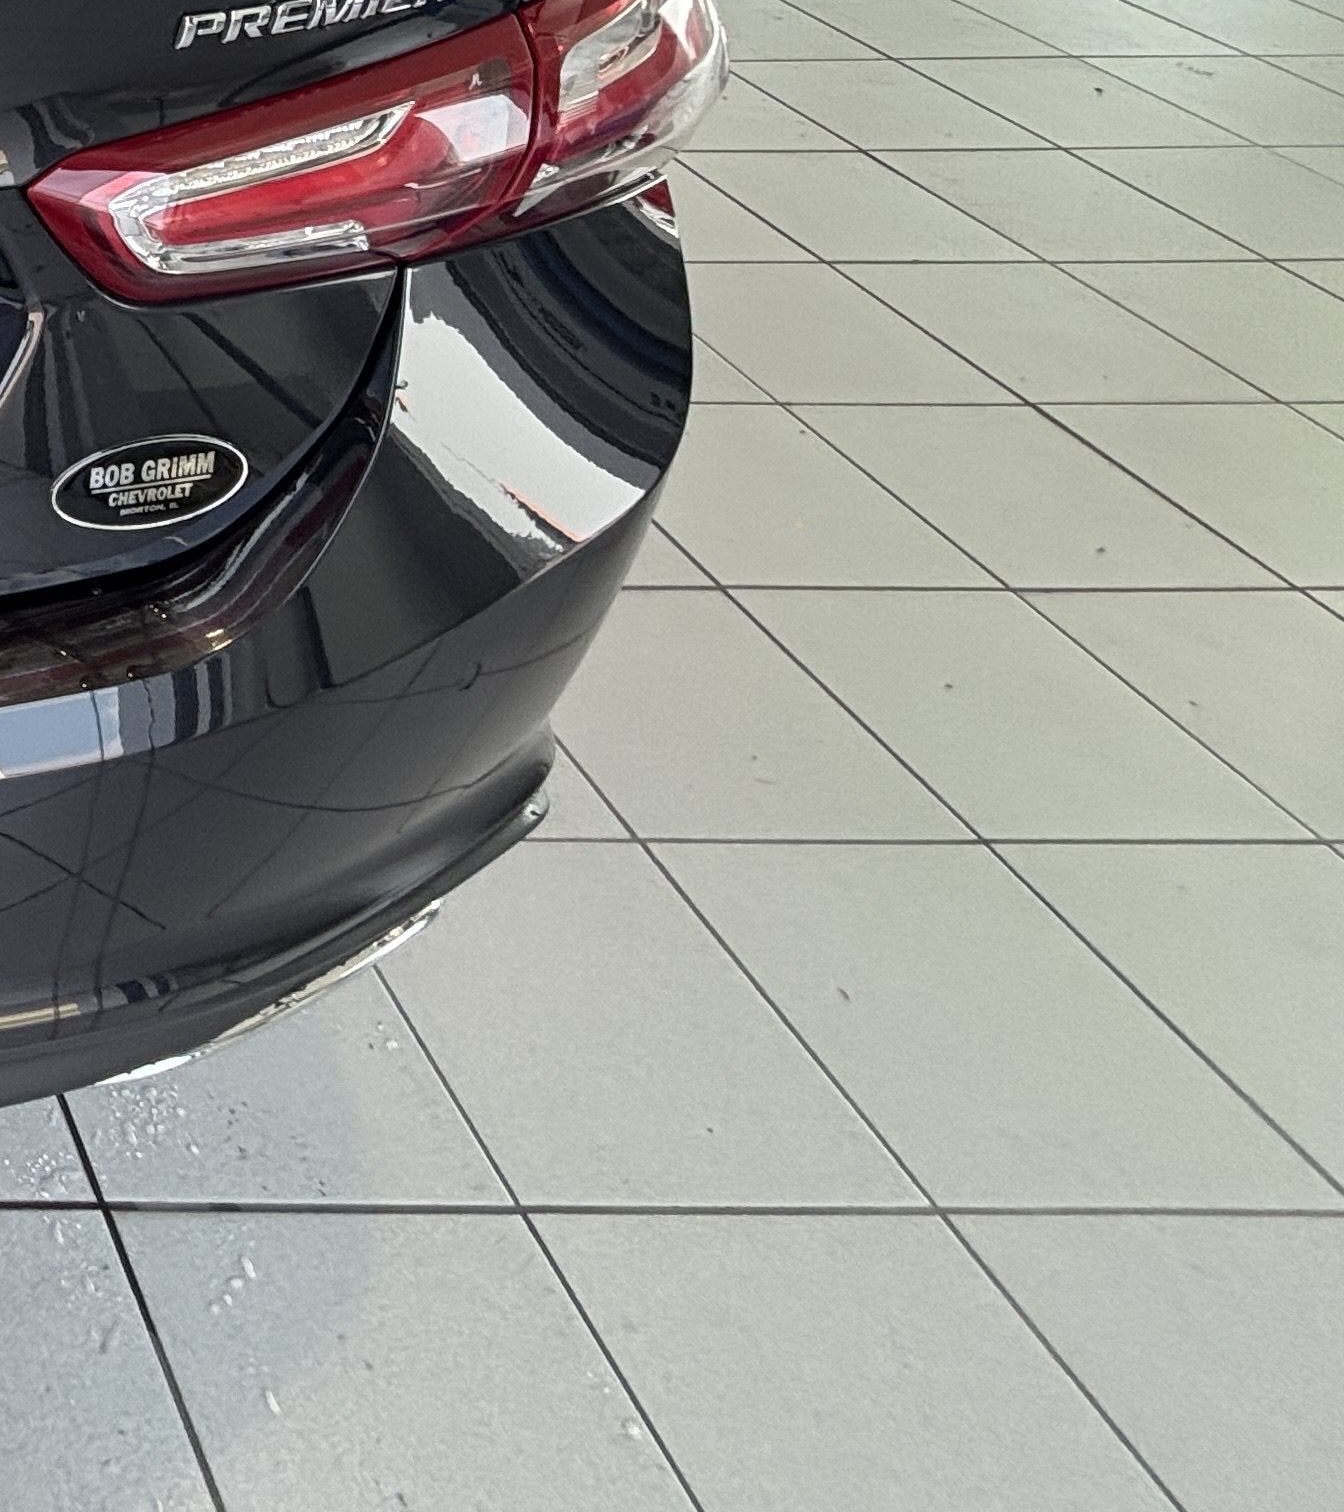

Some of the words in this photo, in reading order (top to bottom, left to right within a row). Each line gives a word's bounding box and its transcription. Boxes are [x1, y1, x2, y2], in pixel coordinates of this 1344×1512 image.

[89, 464, 135, 490] BOB
[140, 450, 216, 481] GRIMM
[108, 482, 194, 508] CHEVROLET
